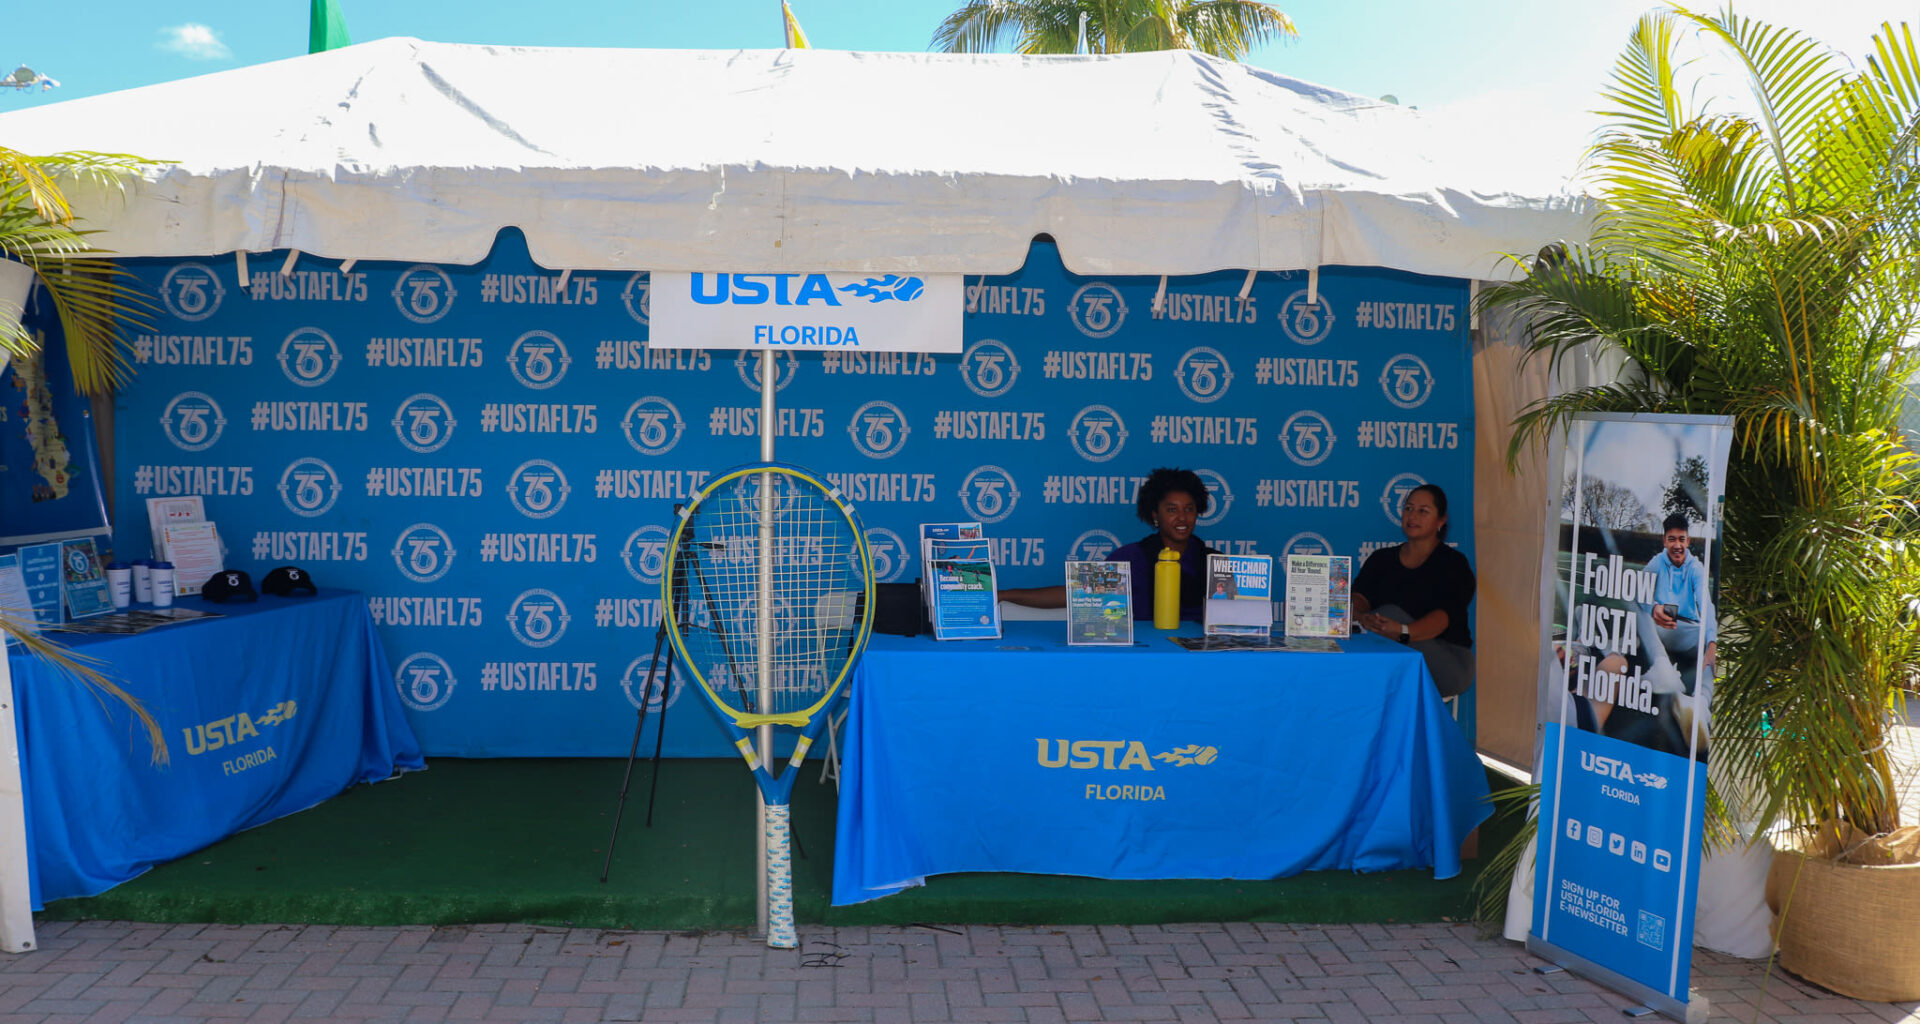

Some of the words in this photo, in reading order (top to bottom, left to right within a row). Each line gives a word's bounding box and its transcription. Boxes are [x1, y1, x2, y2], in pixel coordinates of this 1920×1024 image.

[251, 271, 368, 302] #USTAFL75
[691, 272, 842, 306] USTA
[1357, 302, 1454, 330] #USTAFL75
[134, 334, 253, 365] #USTAFL75
[754, 325, 859, 346] FLORIDA
[367, 338, 482, 368] #USTAFL75
[595, 341, 711, 371] #USTAFL75
[822, 351, 936, 376] #USTAFL75
[1044, 351, 1152, 381] #USTAFL75
[1256, 358, 1358, 386] #USTAFL75
[251, 402, 368, 431] #USTAFL75
[481, 404, 597, 433] #USTAFL75
[934, 411, 1045, 441] #USTAFL75
[1150, 415, 1258, 445] #USTAFL75
[1358, 421, 1458, 449] #USTAFL75
[134, 465, 253, 496] #USTAFL75
[366, 467, 482, 497] #USTAFL75
[1044, 475, 1149, 504] #USTAFL7
[1256, 479, 1359, 508] #USTAFL75
[252, 531, 368, 560] #USTAFL75
[481, 533, 597, 563] #USTAFL75
[990, 537, 1045, 566] AFL75
[1213, 558, 1268, 576] WHEELCHAIR
[1236, 574, 1267, 589] TENNIS
[1583, 552, 1658, 604] Follow
[369, 597, 482, 627] #USTAFL75
[1580, 603, 1638, 656] USTA
[481, 662, 597, 691] #USTAFL75
[1576, 655, 1660, 716] Florida.
[182, 711, 260, 756] USTA
[222, 745, 278, 777] FLORIDA
[1035, 738, 1155, 771] USTA
[1580, 750, 1636, 784] USTA
[1085, 784, 1167, 801] FLORIDA
[1601, 784, 1640, 806] FLORIDA
[1560, 889, 1584, 908] USTA
[1585, 896, 1626, 924] FLORIDA
[1561, 879, 1584, 897] SIGN
[1586, 886, 1599, 901] UP
[1600, 892, 1620, 910] FOR
[1559, 902, 1629, 937] E-NEWSLETTER
